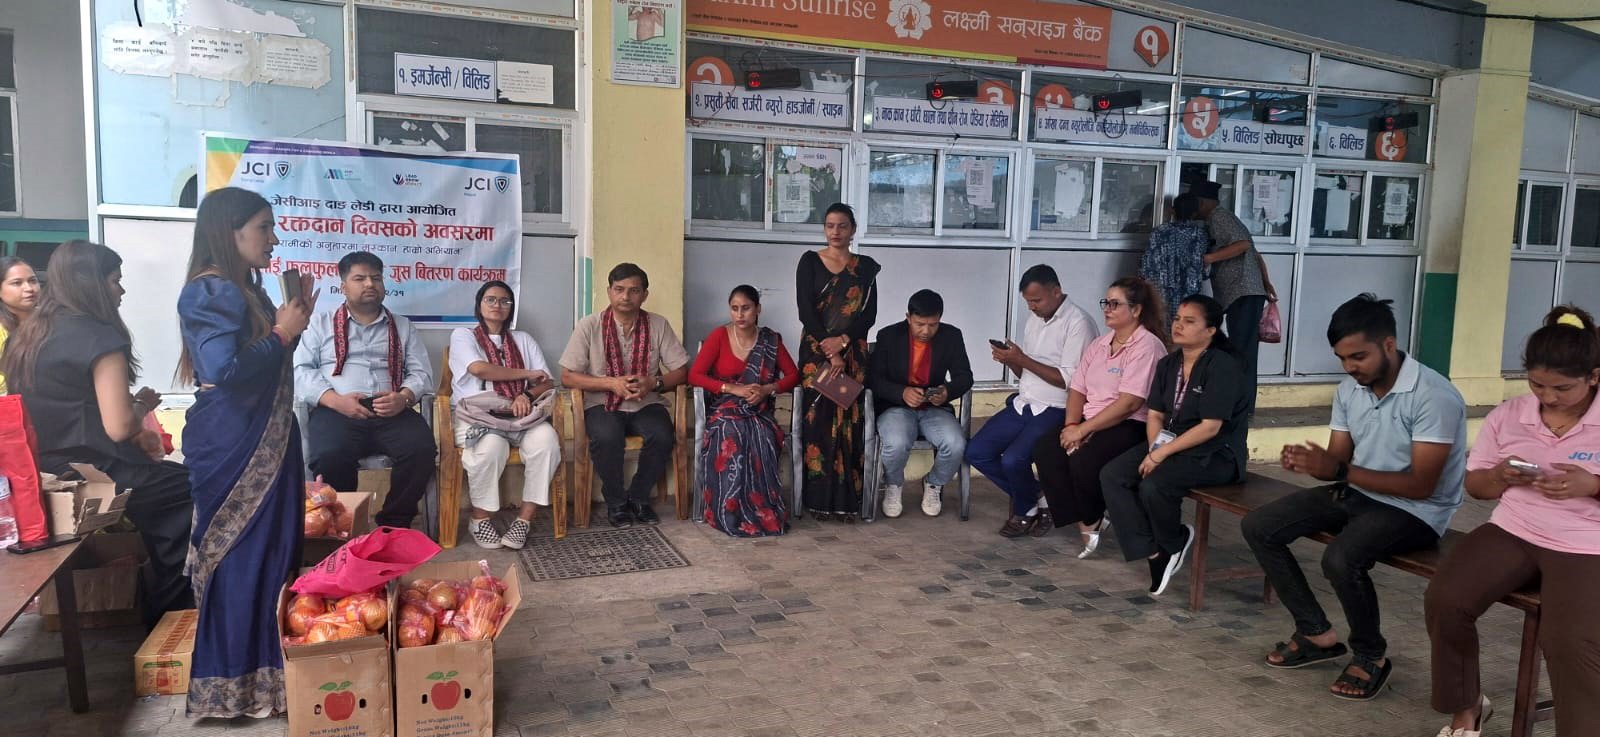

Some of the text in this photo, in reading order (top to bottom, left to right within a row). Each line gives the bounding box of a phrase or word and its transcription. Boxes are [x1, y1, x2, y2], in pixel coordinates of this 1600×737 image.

[943, 10, 990, 31] लक्ष्मी
[1073, 17, 1104, 42] बैंक
[241, 161, 270, 177] JCI
[464, 176, 490, 191] JCI
[351, 199, 375, 212] लेडी
[379, 203, 403, 214] द्वारा
[407, 204, 457, 217] आयोजित
[278, 214, 495, 241] रक्तदान दिवसको अवसरमा
[280, 239, 312, 249] रामीको
[389, 265, 411, 283] जुस
[415, 262, 454, 281] बितरण
[458, 265, 506, 282] कार्यक्रम
[1568, 451, 1594, 461] JCI
